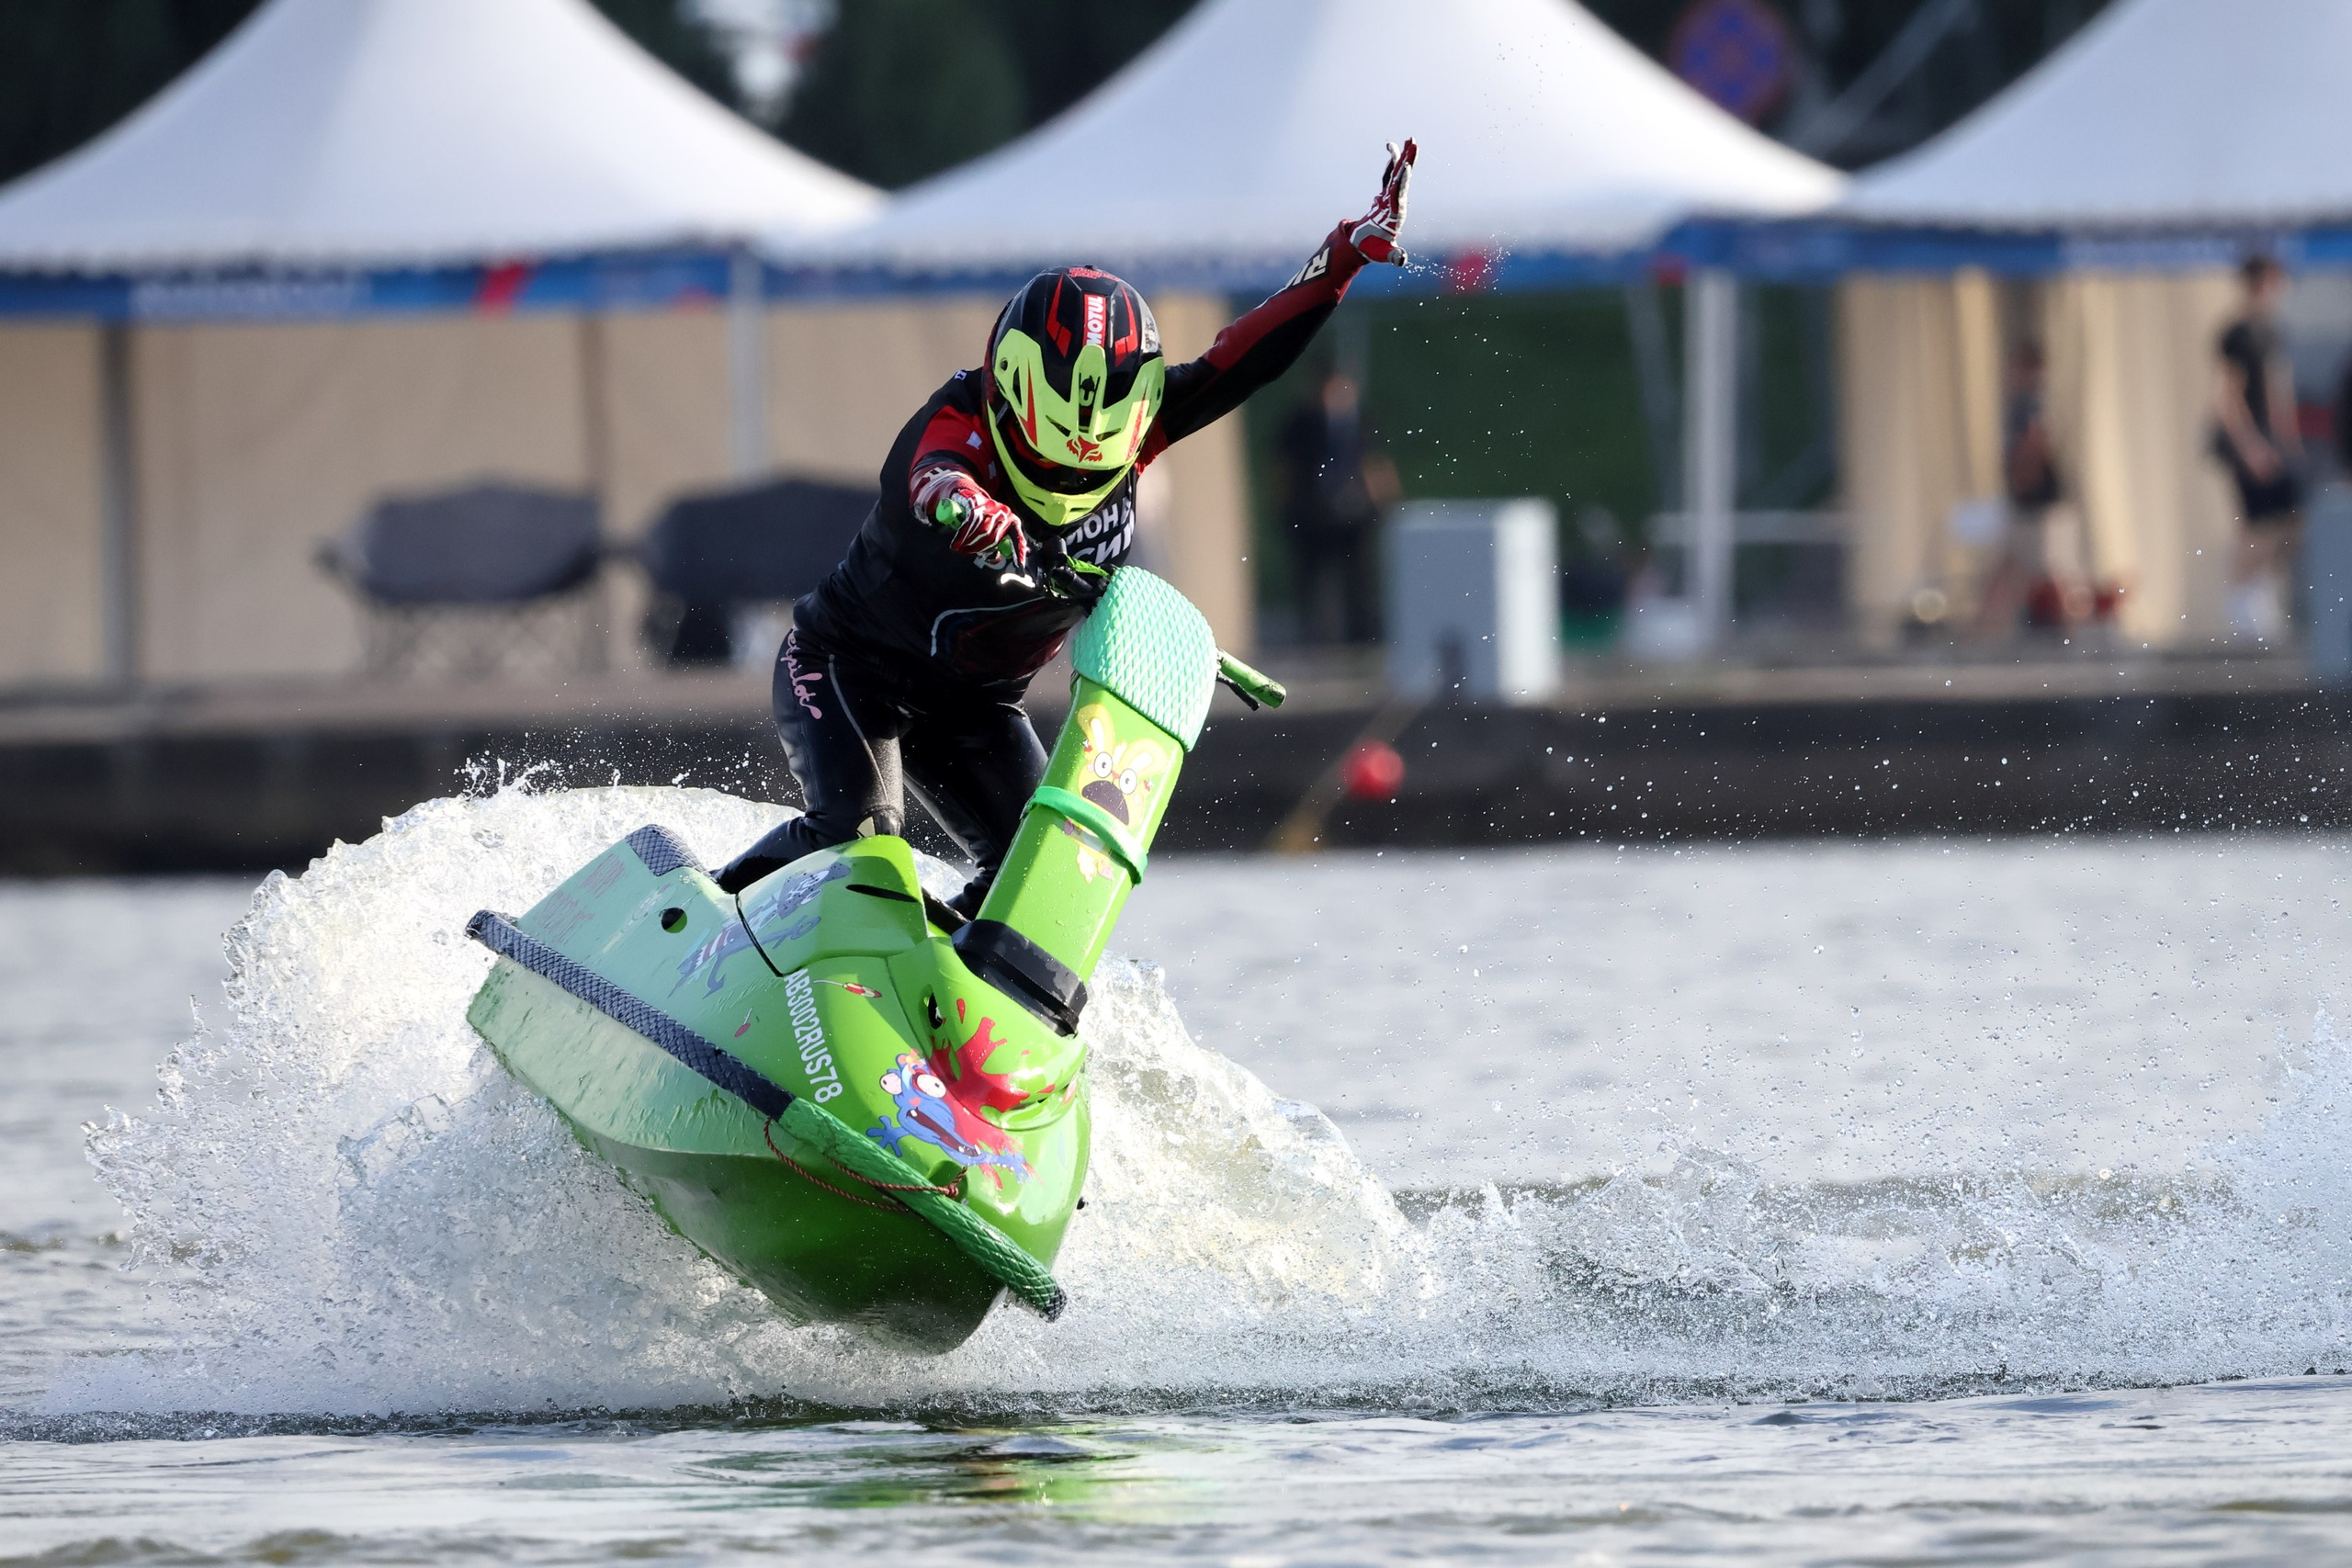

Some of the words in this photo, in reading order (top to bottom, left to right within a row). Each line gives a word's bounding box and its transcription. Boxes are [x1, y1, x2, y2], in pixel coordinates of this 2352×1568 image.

[1086, 296, 1103, 345] MOTUL
[780, 624, 825, 720] etpilot
[784, 967, 843, 1103] AB3002RUS78
